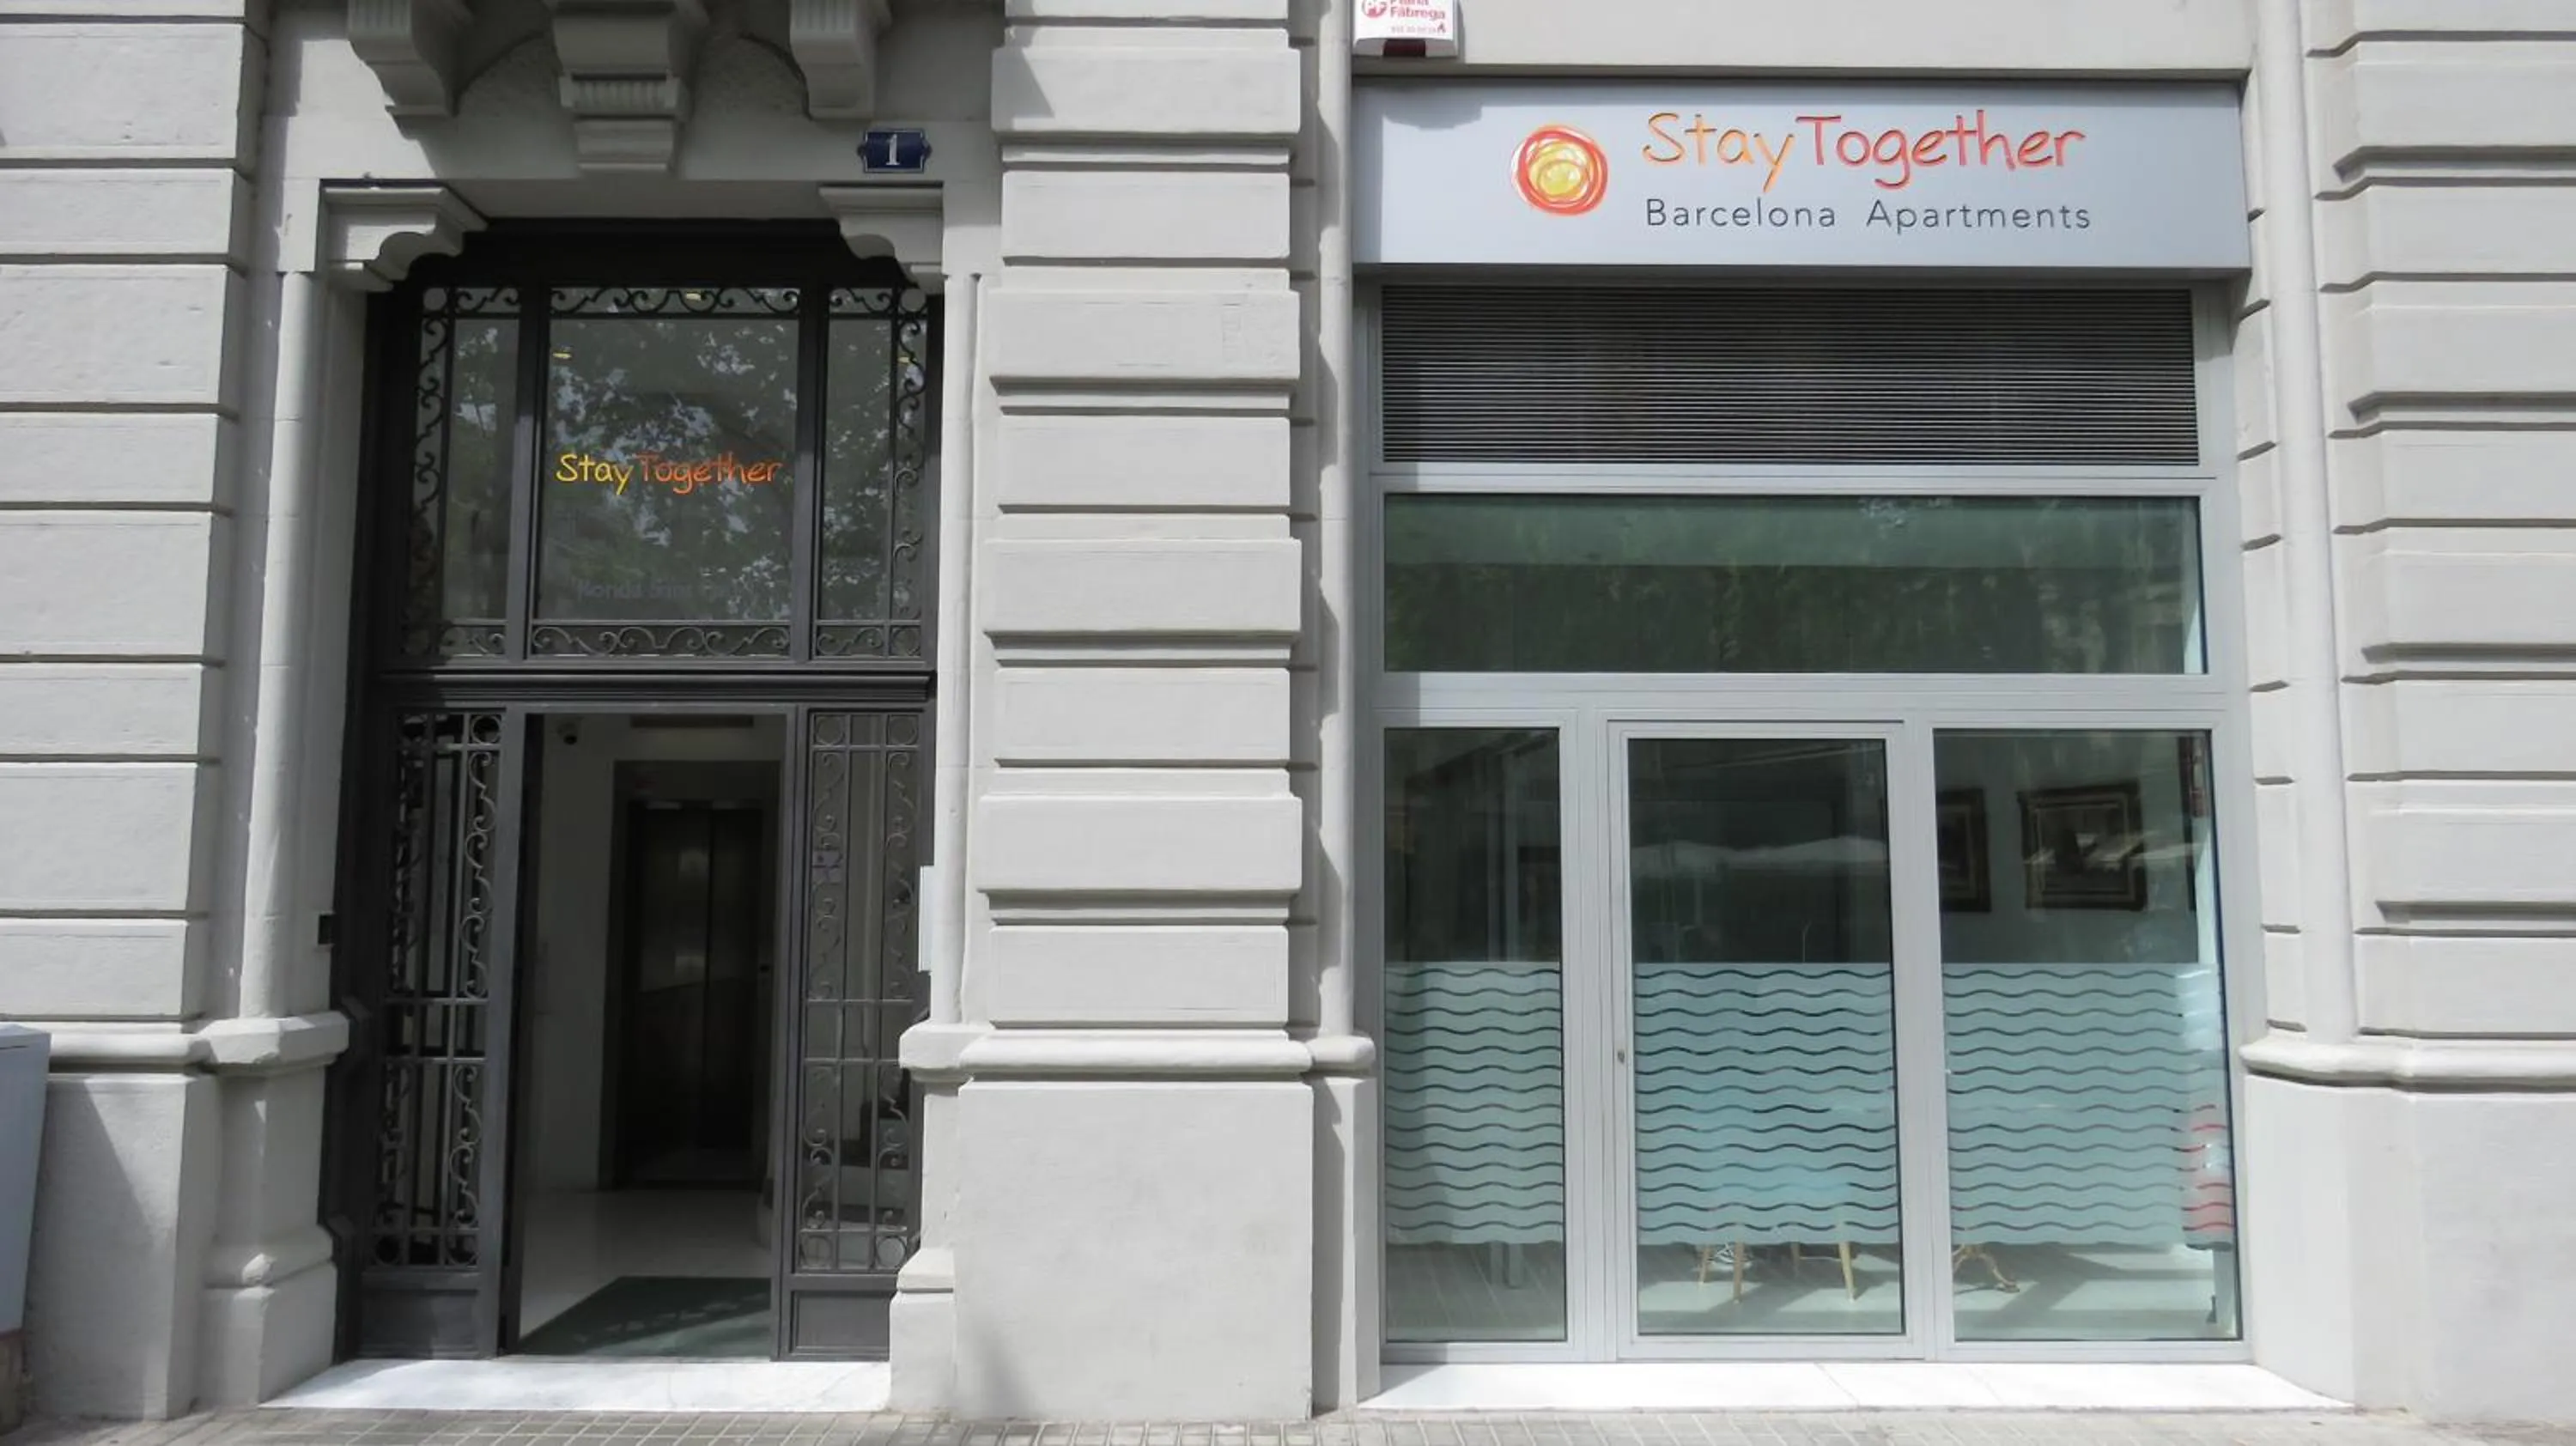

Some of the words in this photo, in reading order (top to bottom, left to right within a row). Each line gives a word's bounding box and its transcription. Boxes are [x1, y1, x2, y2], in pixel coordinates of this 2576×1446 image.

[885, 133, 901, 166] 1
[1646, 198, 1838, 229] Barcelona
[1866, 198, 2092, 236] Apartments
